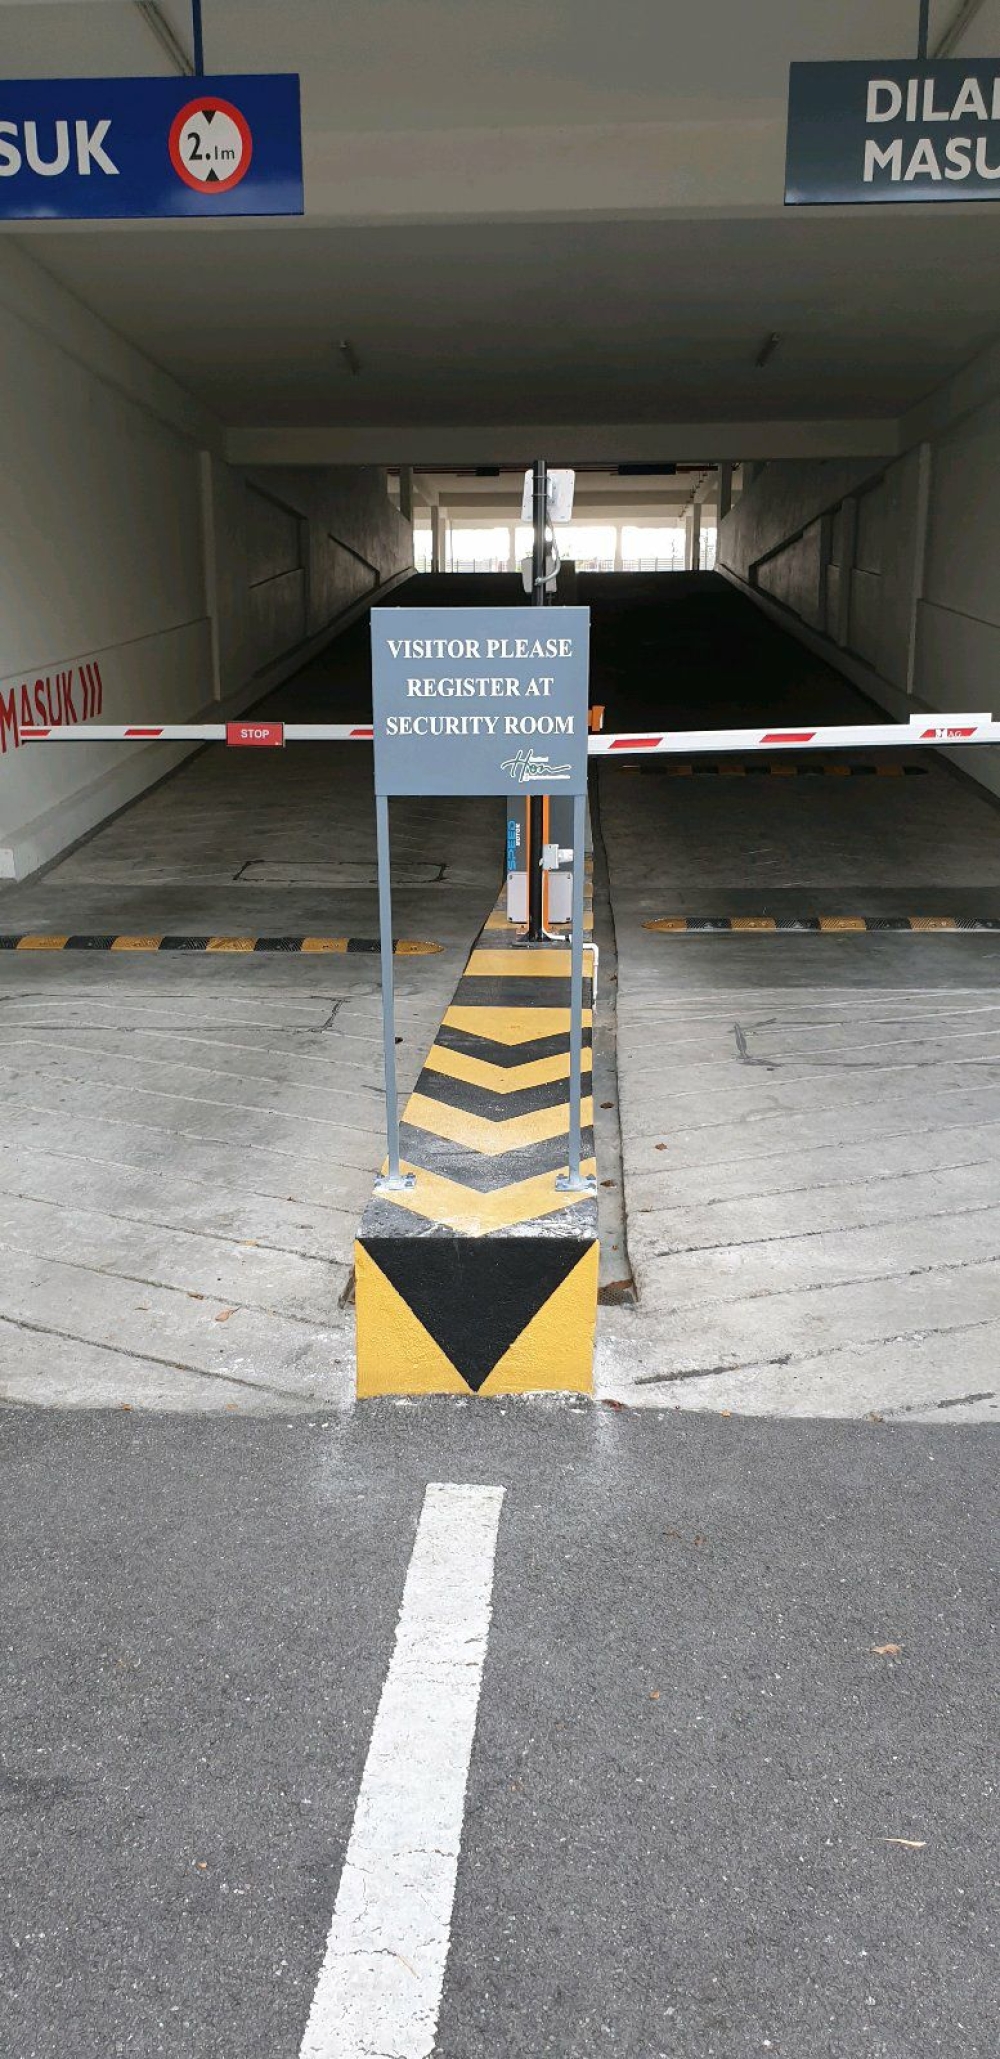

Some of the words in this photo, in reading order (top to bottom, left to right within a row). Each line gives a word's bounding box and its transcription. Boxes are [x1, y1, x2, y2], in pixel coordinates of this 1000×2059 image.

[866, 77, 1000, 123] DILA
[386, 639, 482, 659] VISITOR
[486, 638, 573, 658] PLEASE
[406, 677, 520, 697] REGISTER
[525, 677, 554, 696] AT
[0, 669, 78, 754] MASUK
[240, 729, 270, 739] STOP
[386, 716, 499, 736] SECURITY
[503, 715, 575, 735] ROOM
[507, 820, 516, 871] SPEED
